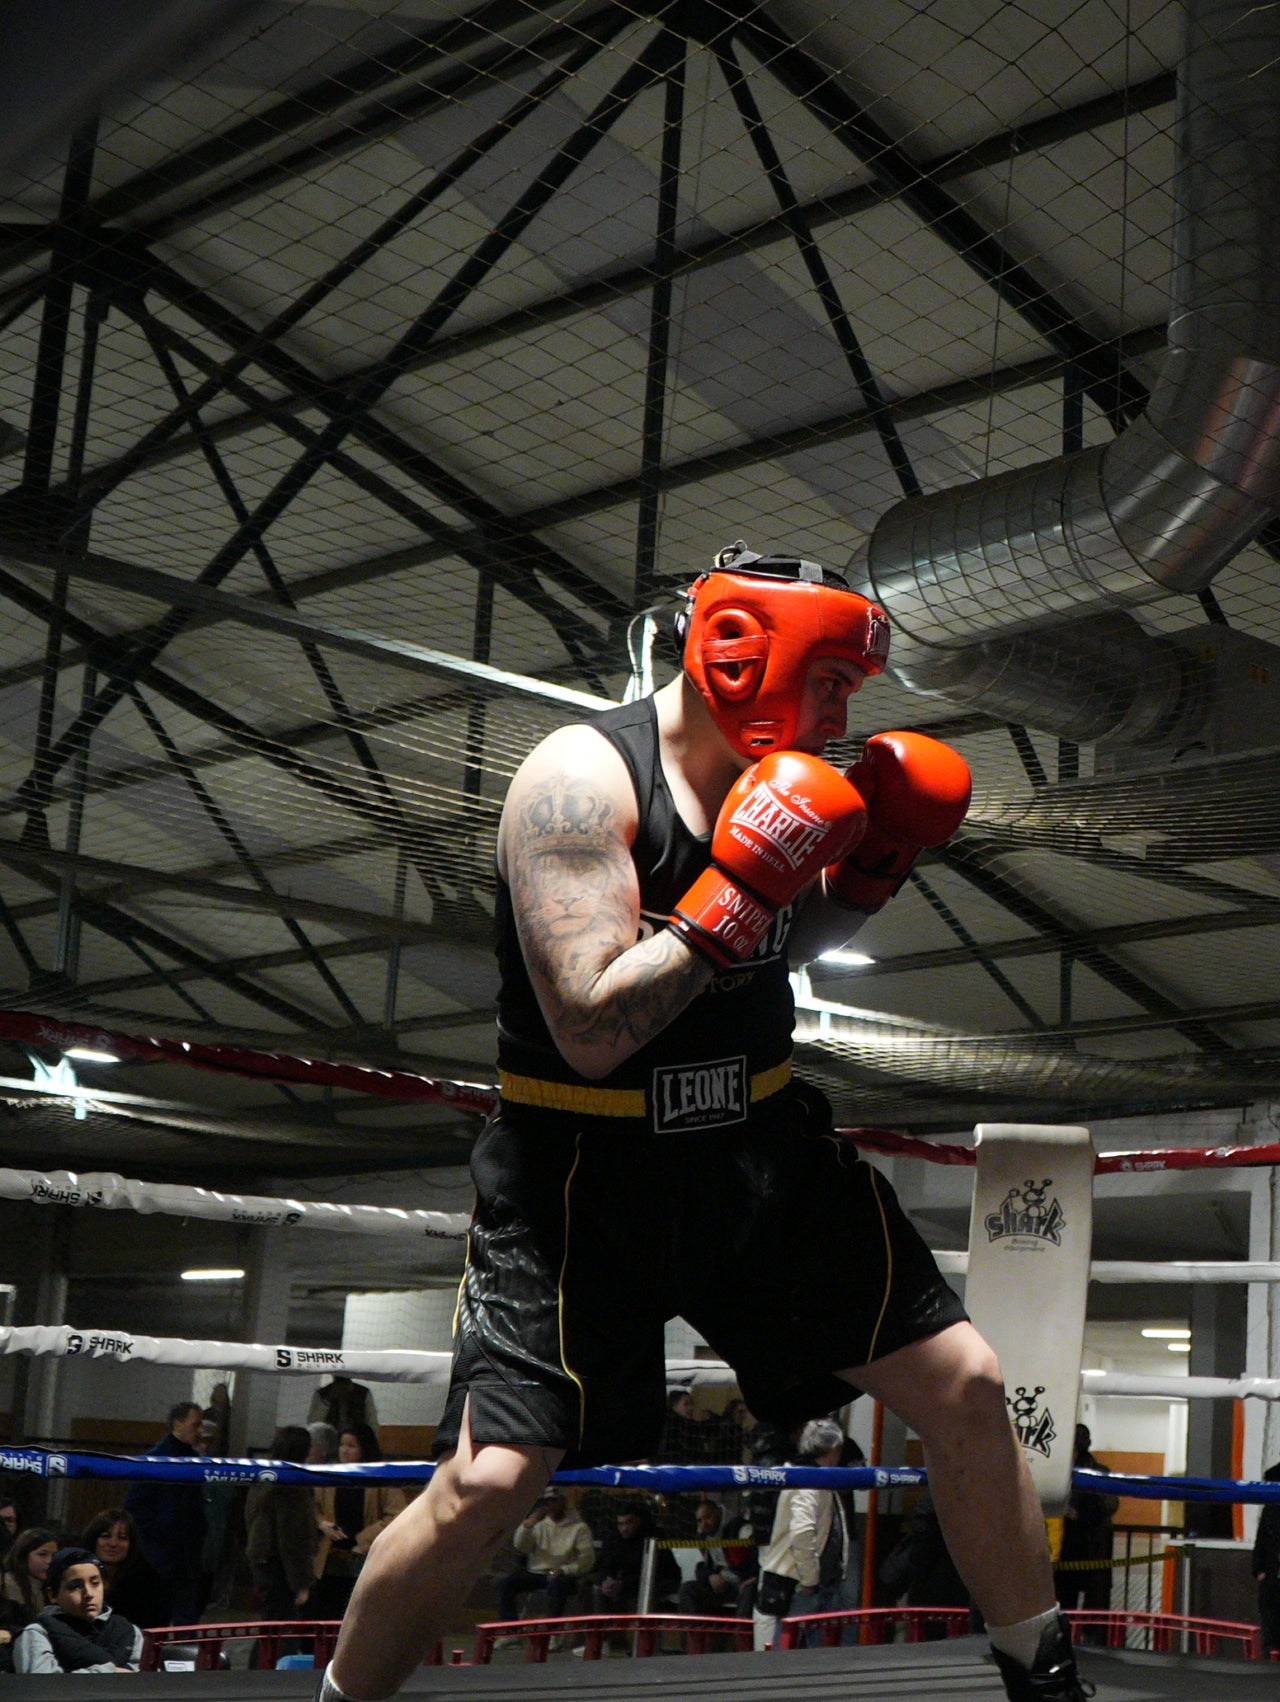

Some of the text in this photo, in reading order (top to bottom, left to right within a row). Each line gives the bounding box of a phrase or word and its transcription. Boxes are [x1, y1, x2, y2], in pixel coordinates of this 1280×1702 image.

[732, 787, 825, 867] CHARLIE
[729, 825, 754, 848] MADE
[752, 843, 764, 856] IN
[712, 915, 738, 939] 10
[662, 1064, 740, 1123] LEONE
[30, 1184, 81, 1204] SHARK
[90, 1336, 134, 1354] SHARK
[297, 1352, 345, 1363] SHARK
[0, 1456, 43, 1474] SHAR
[749, 1469, 787, 1481] SHARK
